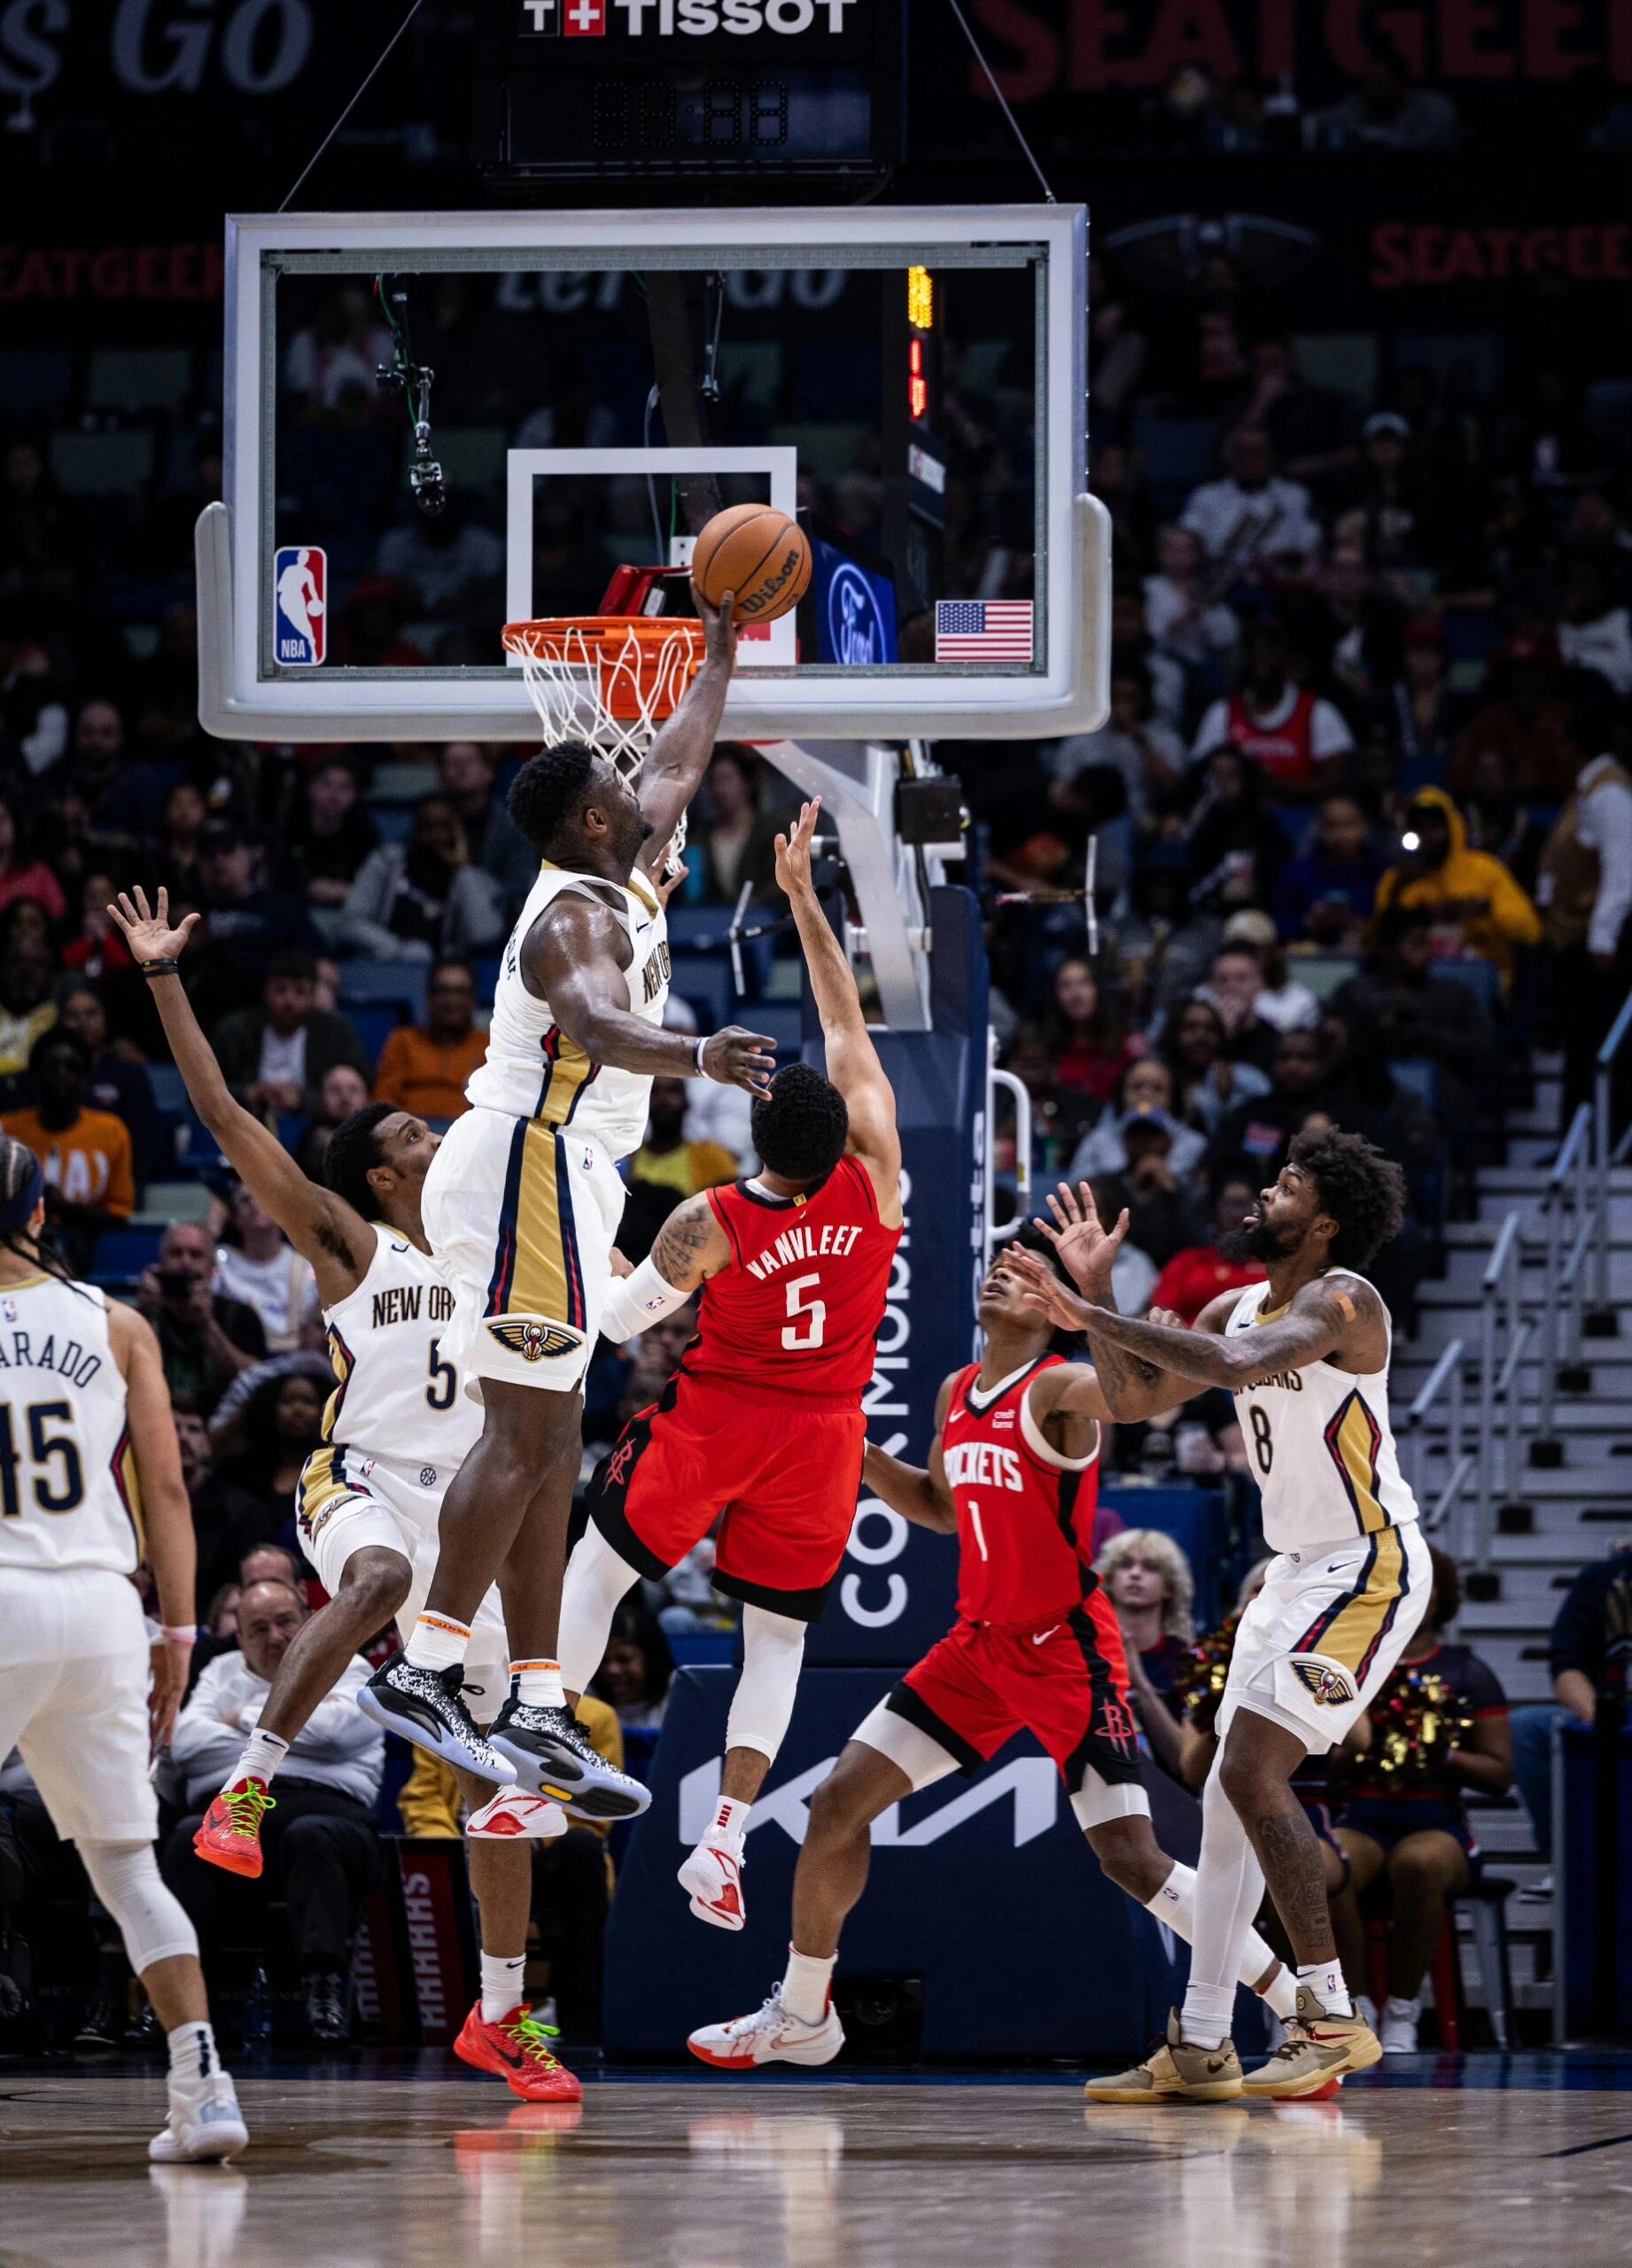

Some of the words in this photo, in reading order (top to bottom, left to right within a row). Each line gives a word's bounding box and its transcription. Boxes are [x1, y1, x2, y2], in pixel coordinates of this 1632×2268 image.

[614, 0, 858, 36] TISSOT
[742, 550, 800, 613] Wilson
[281, 638, 307, 659] NBA
[745, 1224, 863, 1281] VANVLEET
[372, 1285, 424, 1329] NEW
[781, 1272, 827, 1351] 5
[425, 1336, 457, 1413] 5
[1249, 1402, 1273, 1475] 8
[967, 1500, 990, 1562] 1
